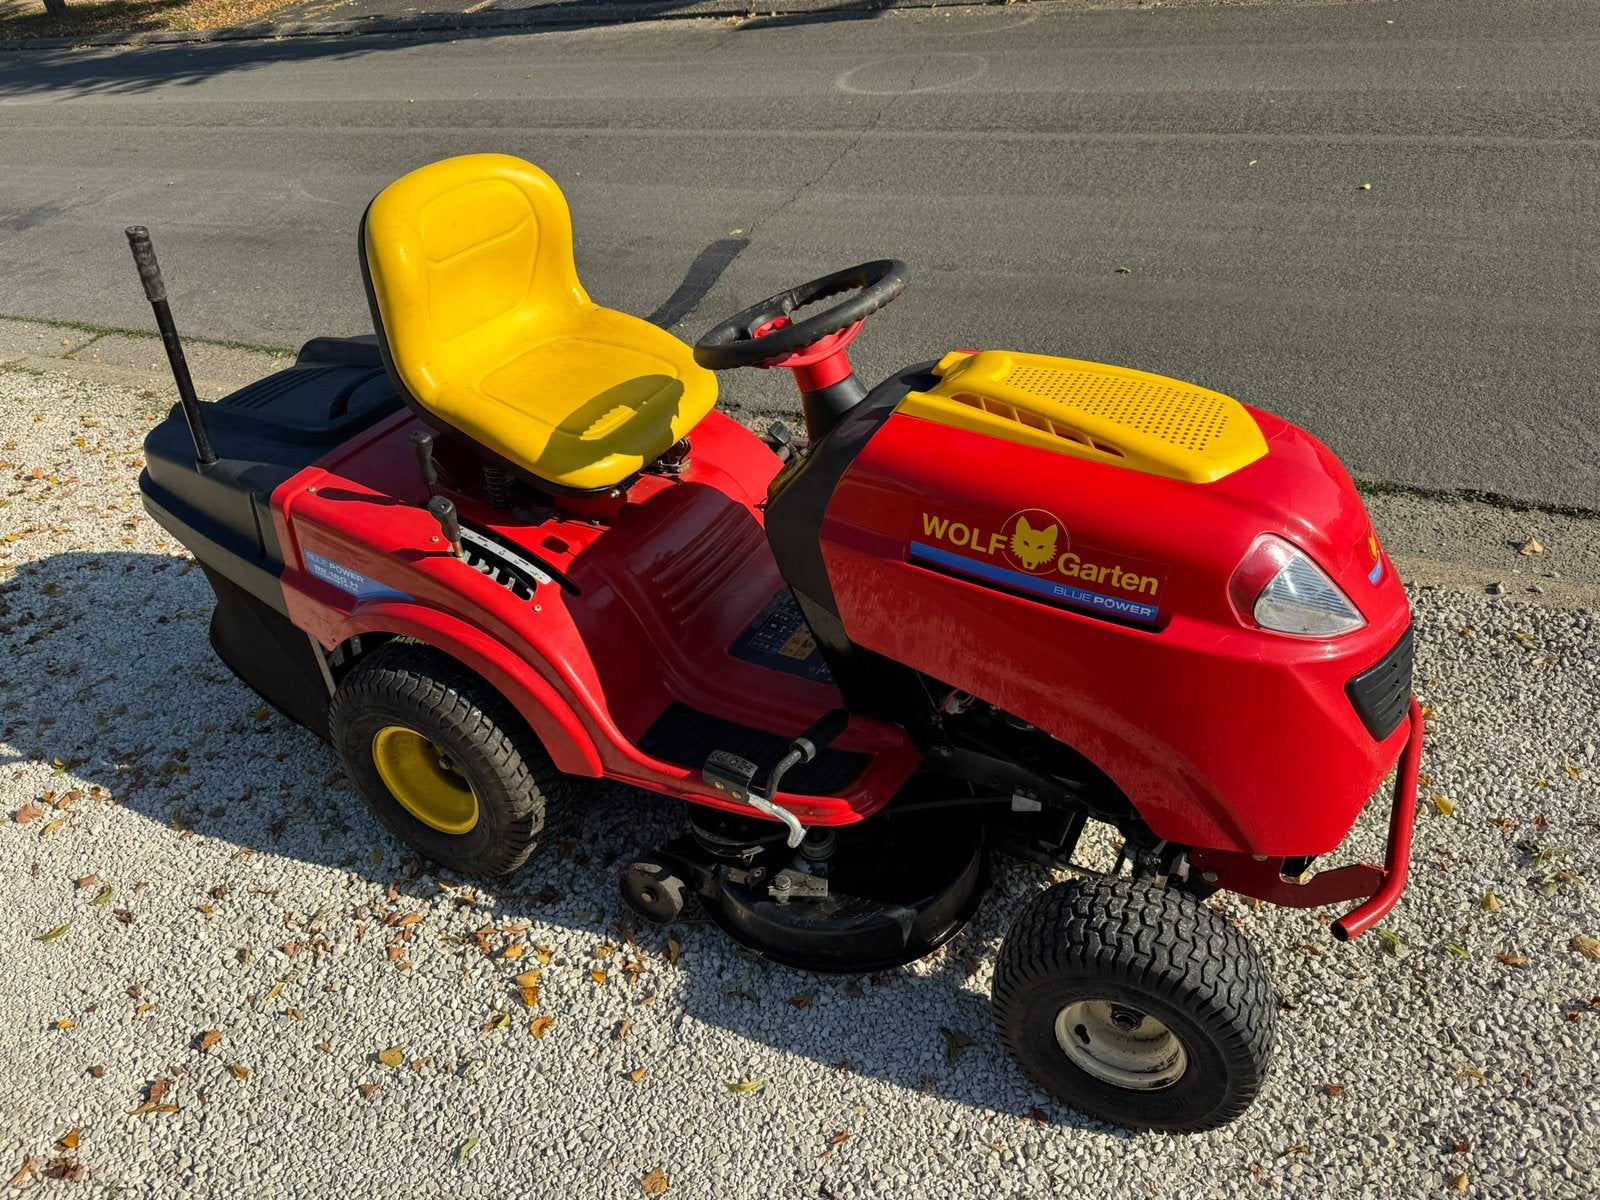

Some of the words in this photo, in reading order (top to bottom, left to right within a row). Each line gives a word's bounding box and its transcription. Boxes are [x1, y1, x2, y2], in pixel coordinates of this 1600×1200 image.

[923, 513, 1008, 555] WOLF
[1057, 552, 1159, 596] Garten
[1054, 586, 1092, 602] BLUE
[1093, 596, 1152, 617] POWER
